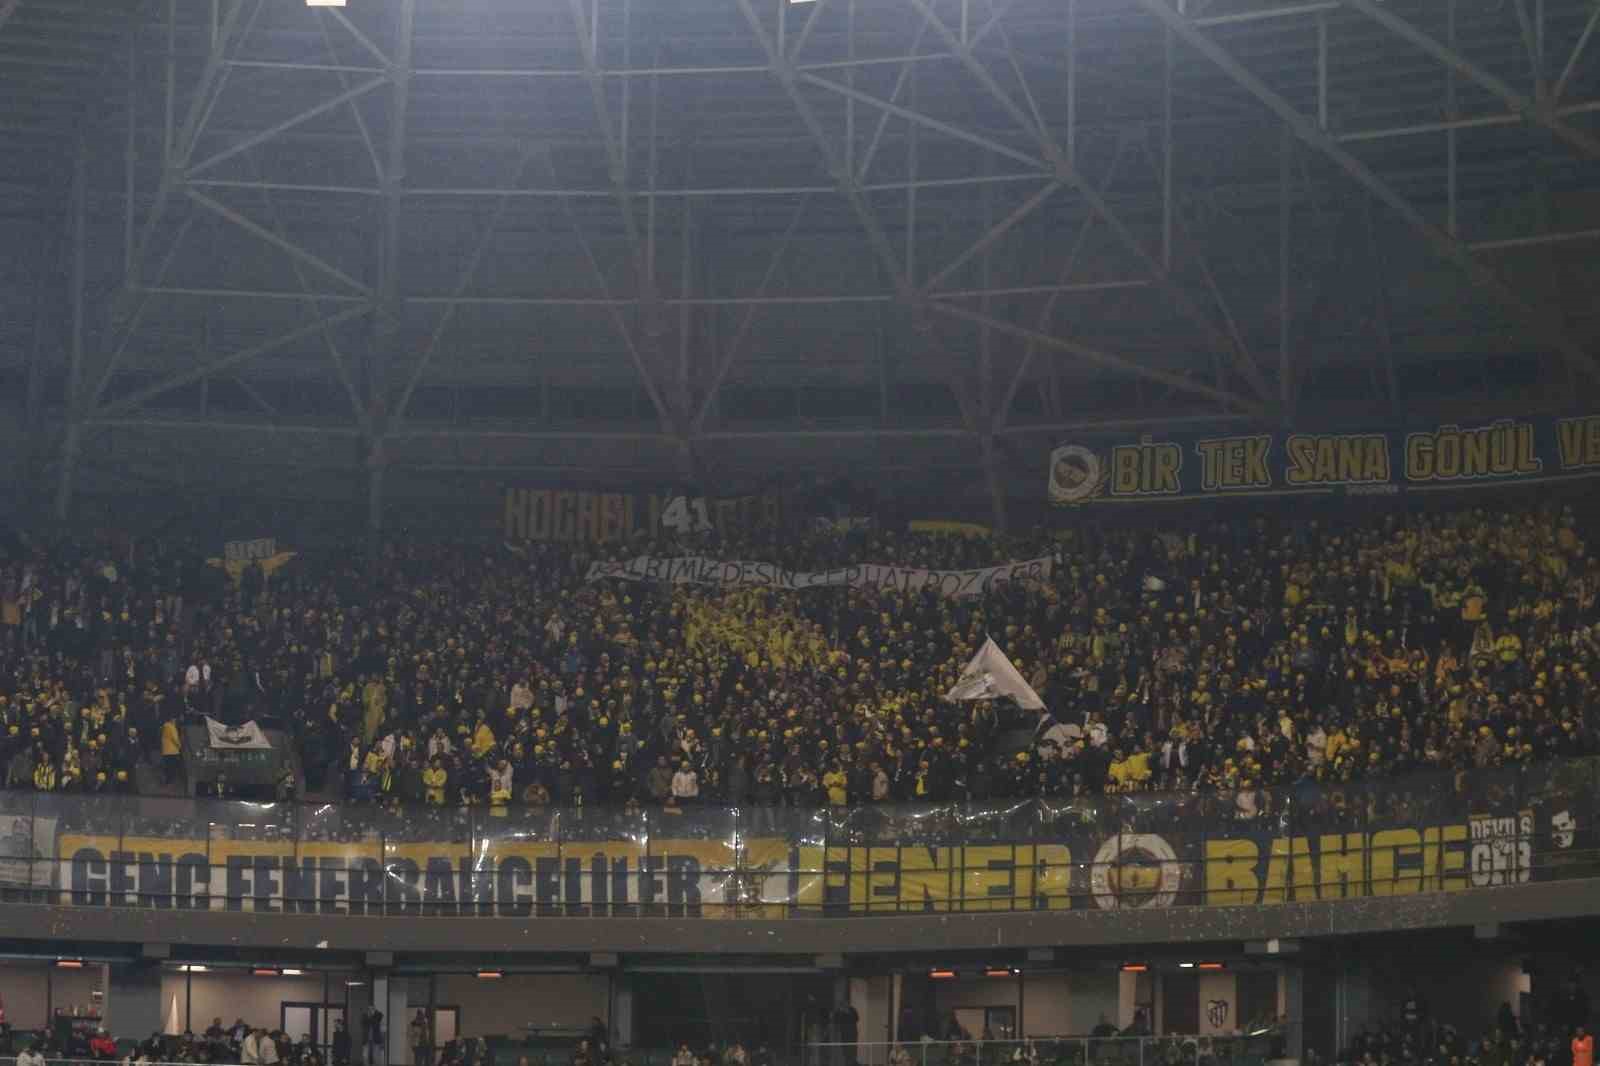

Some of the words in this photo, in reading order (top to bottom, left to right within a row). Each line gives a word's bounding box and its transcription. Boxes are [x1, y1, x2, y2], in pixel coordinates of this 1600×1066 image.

[1111, 433, 1182, 494] BİR
[1194, 435, 1268, 488] TEK
[1284, 432, 1391, 485] SANA
[1403, 418, 1542, 481] GÖNÜL
[659, 495, 712, 534] 41
[797, 844, 1069, 912] FENER
